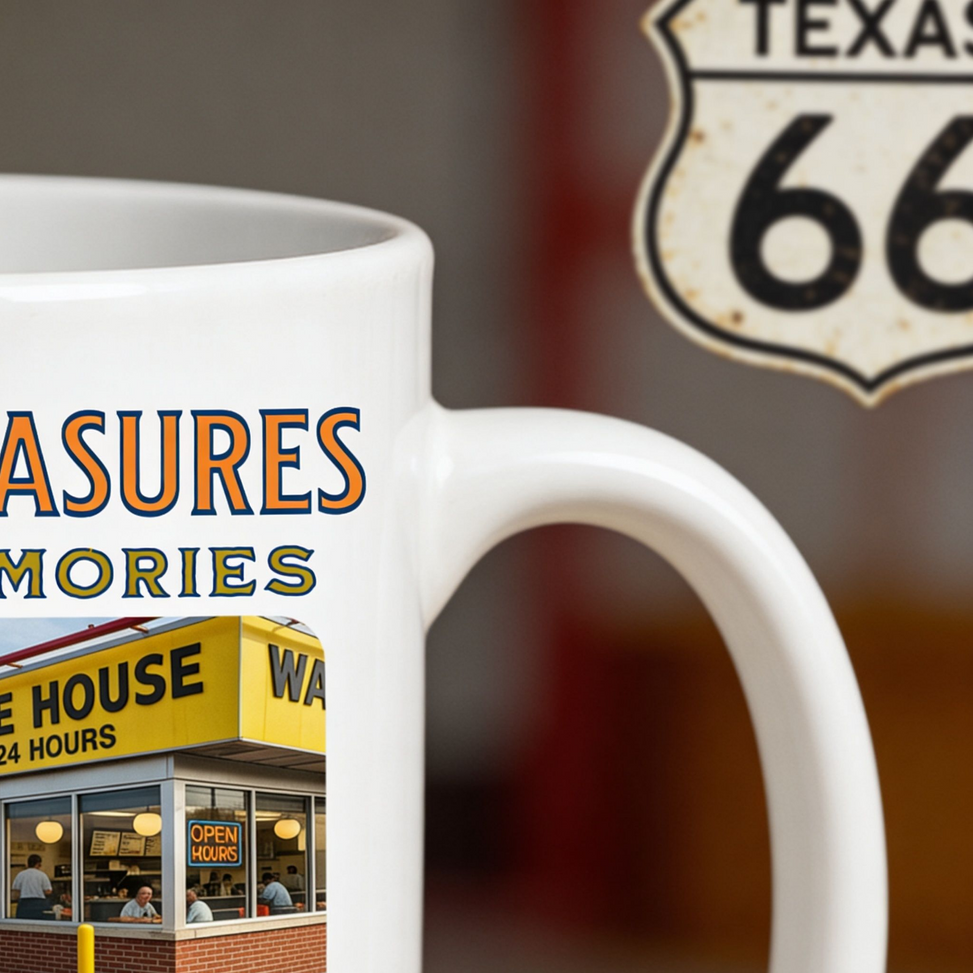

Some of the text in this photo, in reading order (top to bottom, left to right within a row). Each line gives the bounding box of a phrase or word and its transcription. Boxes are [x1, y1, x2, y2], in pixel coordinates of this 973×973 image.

[741, 0, 973, 58] TEXA
[728, 113, 973, 313] 66
[31, 642, 204, 728] HOUSE
[29, 724, 117, 761] HOURS
[191, 824, 238, 844] OPEN
[192, 845, 238, 862] HOURS
